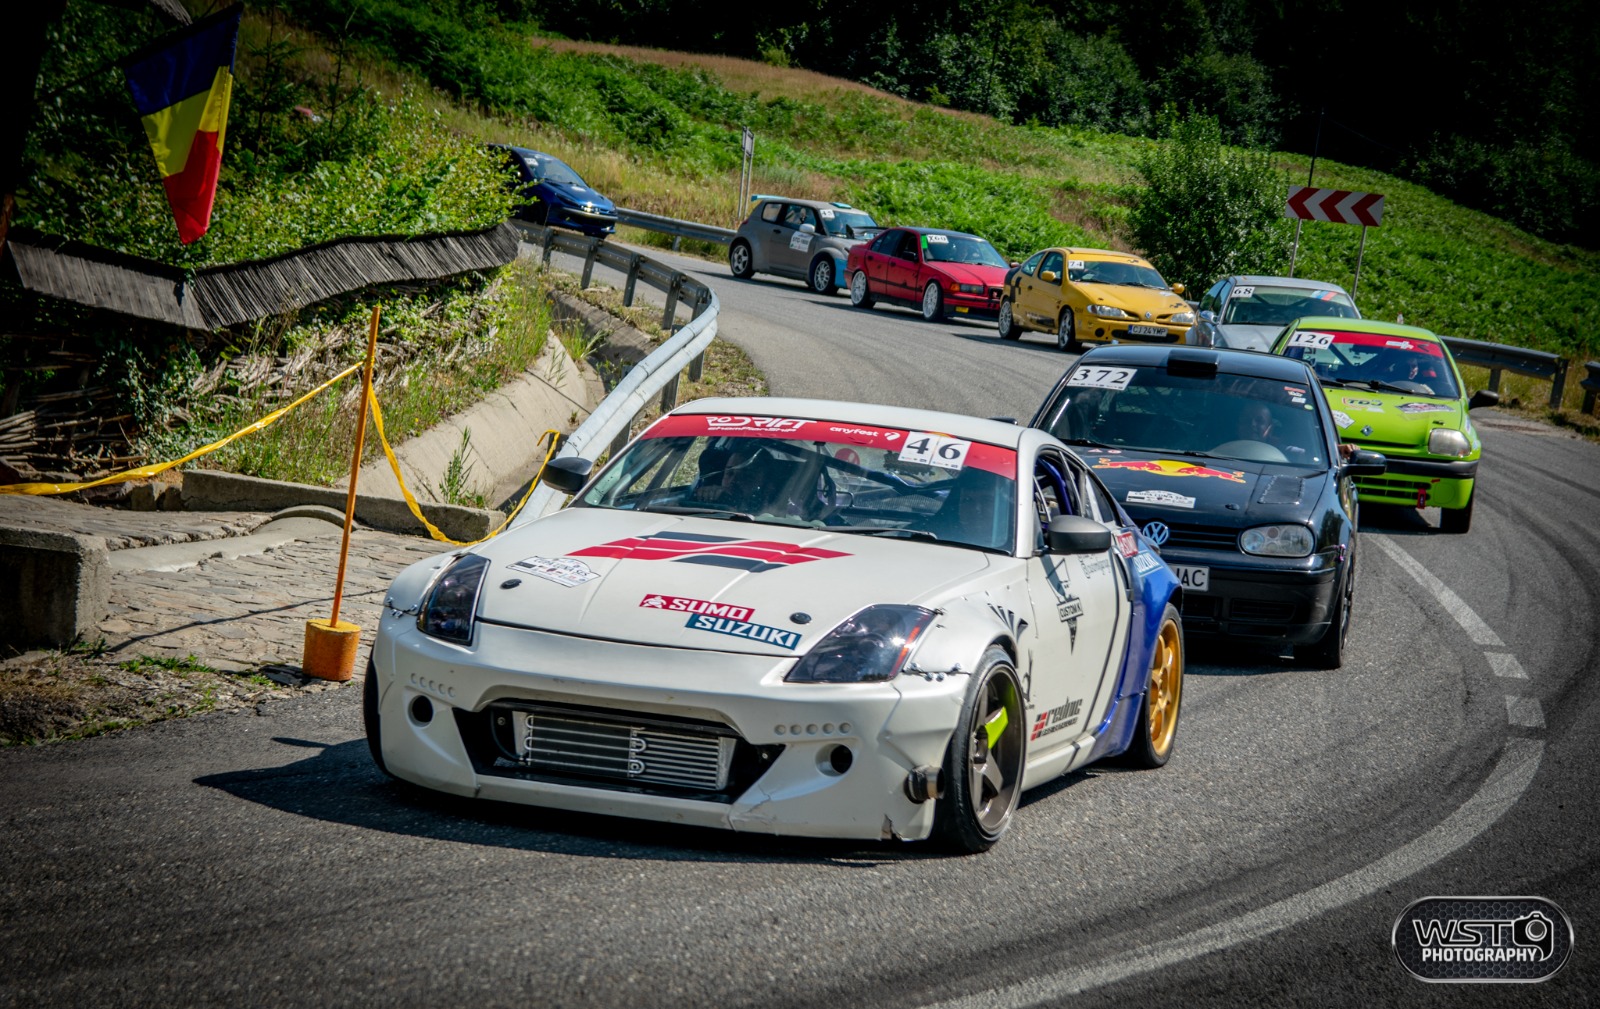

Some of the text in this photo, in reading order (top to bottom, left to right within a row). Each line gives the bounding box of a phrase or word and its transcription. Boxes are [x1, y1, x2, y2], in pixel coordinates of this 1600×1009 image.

[1294, 334, 1328, 345] 126
[1072, 369, 1129, 384] 372
[906, 437, 964, 460] 46
[668, 598, 748, 620] SUMO
[694, 615, 797, 648] SUZUKI
